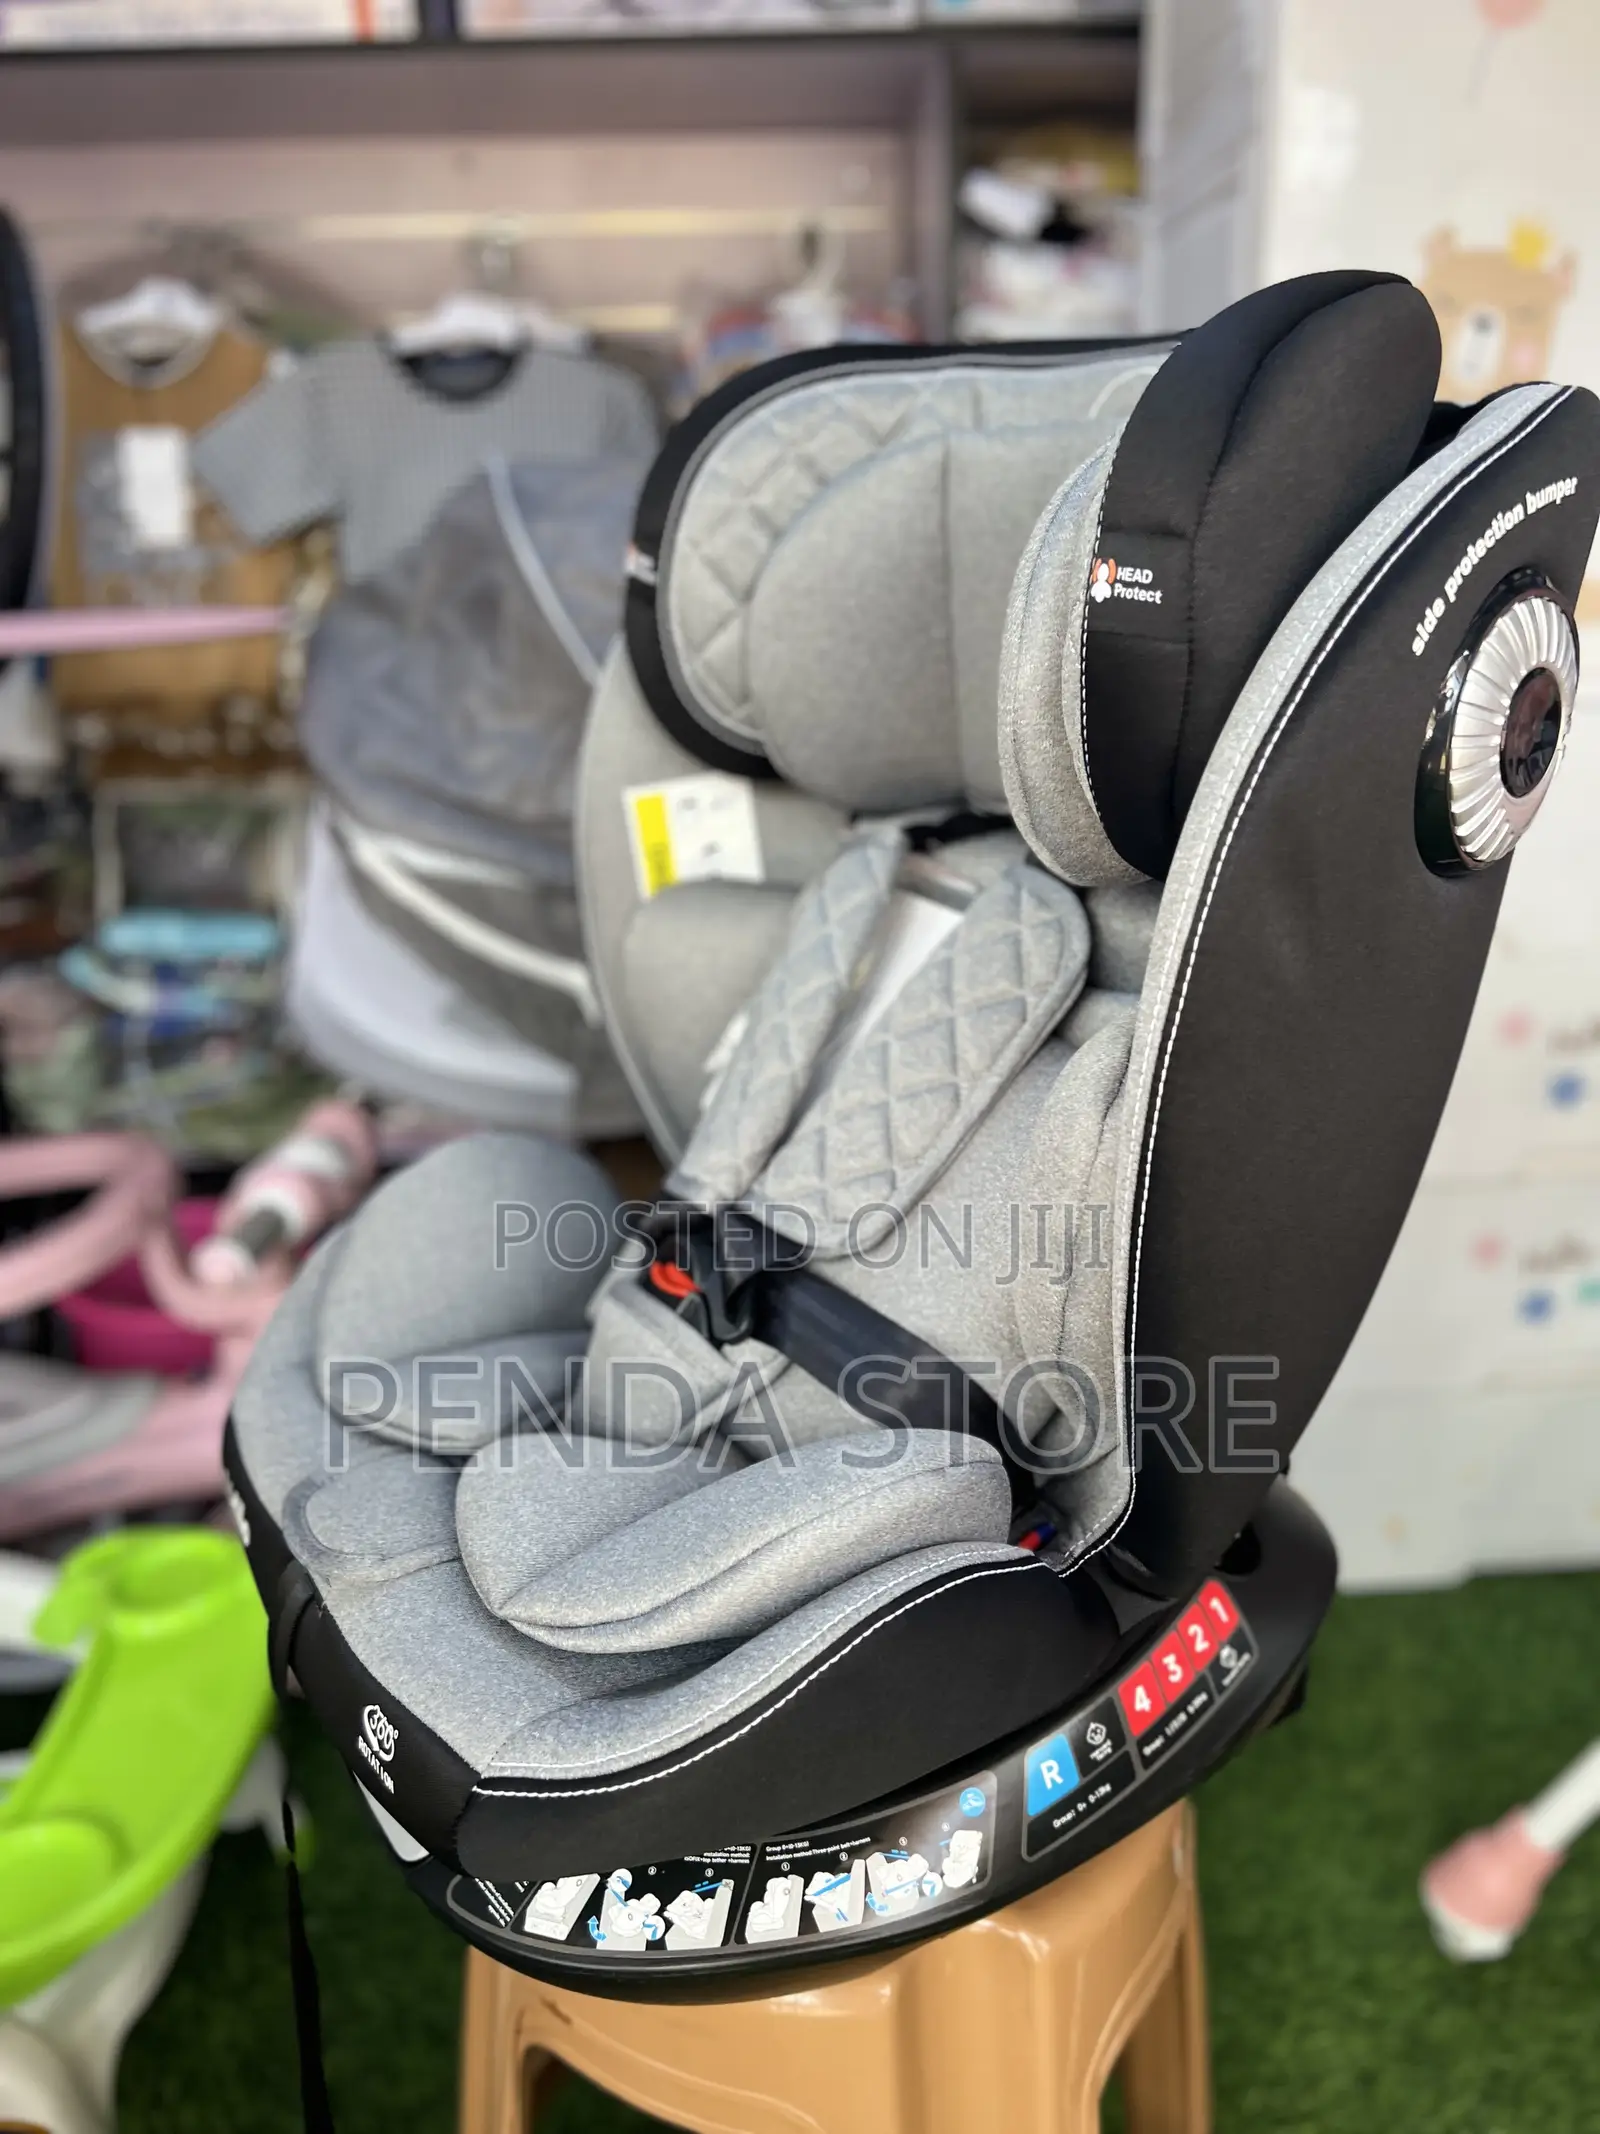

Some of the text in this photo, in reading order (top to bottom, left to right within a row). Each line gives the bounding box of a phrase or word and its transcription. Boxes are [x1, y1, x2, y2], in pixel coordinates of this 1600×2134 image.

[1117, 567, 1153, 584] HEAD
[1412, 476, 1578, 656] side protection bumper
[1114, 583, 1163, 604] Protect
[1134, 1596, 1229, 1713] 4 3 2 1
[358, 1735, 395, 1794] ROTATION
[1040, 1759, 1064, 1790] R
[766, 1844, 781, 1852] Group
[766, 1853, 793, 1861] Installation
